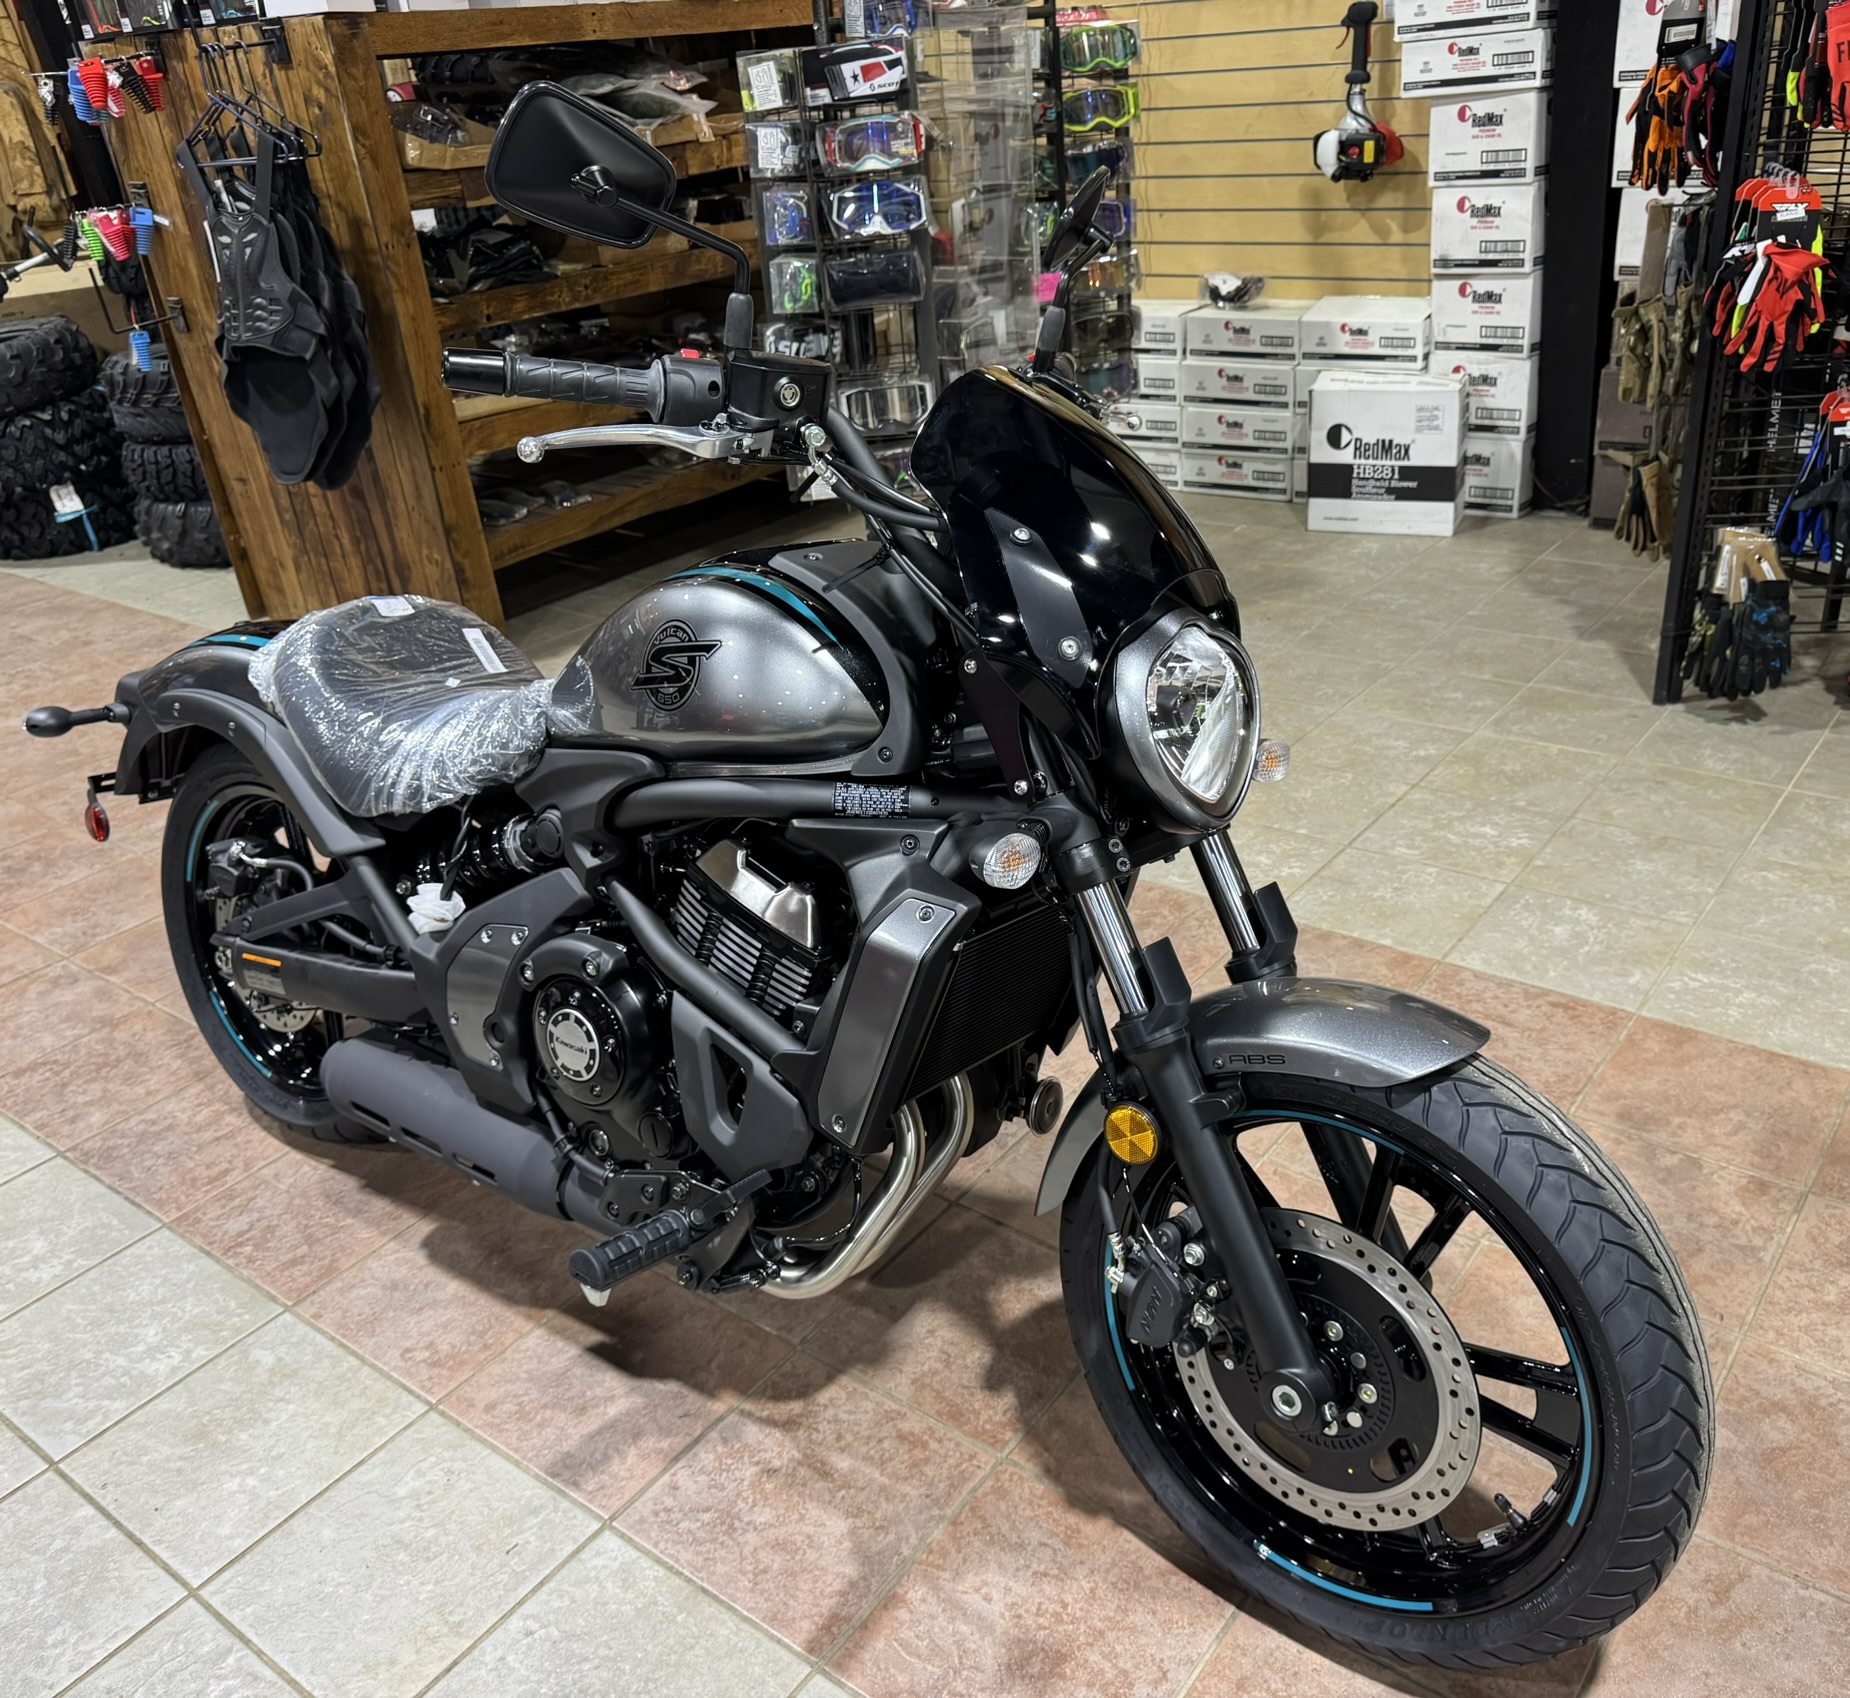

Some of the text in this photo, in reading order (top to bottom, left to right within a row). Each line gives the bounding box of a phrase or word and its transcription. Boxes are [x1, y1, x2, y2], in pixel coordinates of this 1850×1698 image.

[1471, 112, 1504, 128] RedMax
[1470, 204, 1502, 218] RedMax
[1471, 290, 1503, 304] RedMax
[1767, 391, 1783, 452] HELMET
[1353, 437, 1411, 462] RedMax
[1464, 453, 1490, 467] edMax
[1352, 465, 1399, 479] HB281
[657, 692, 681, 704] 650
[555, 1035, 588, 1055] Kawasaki
[1228, 1054, 1286, 1065] ABS
